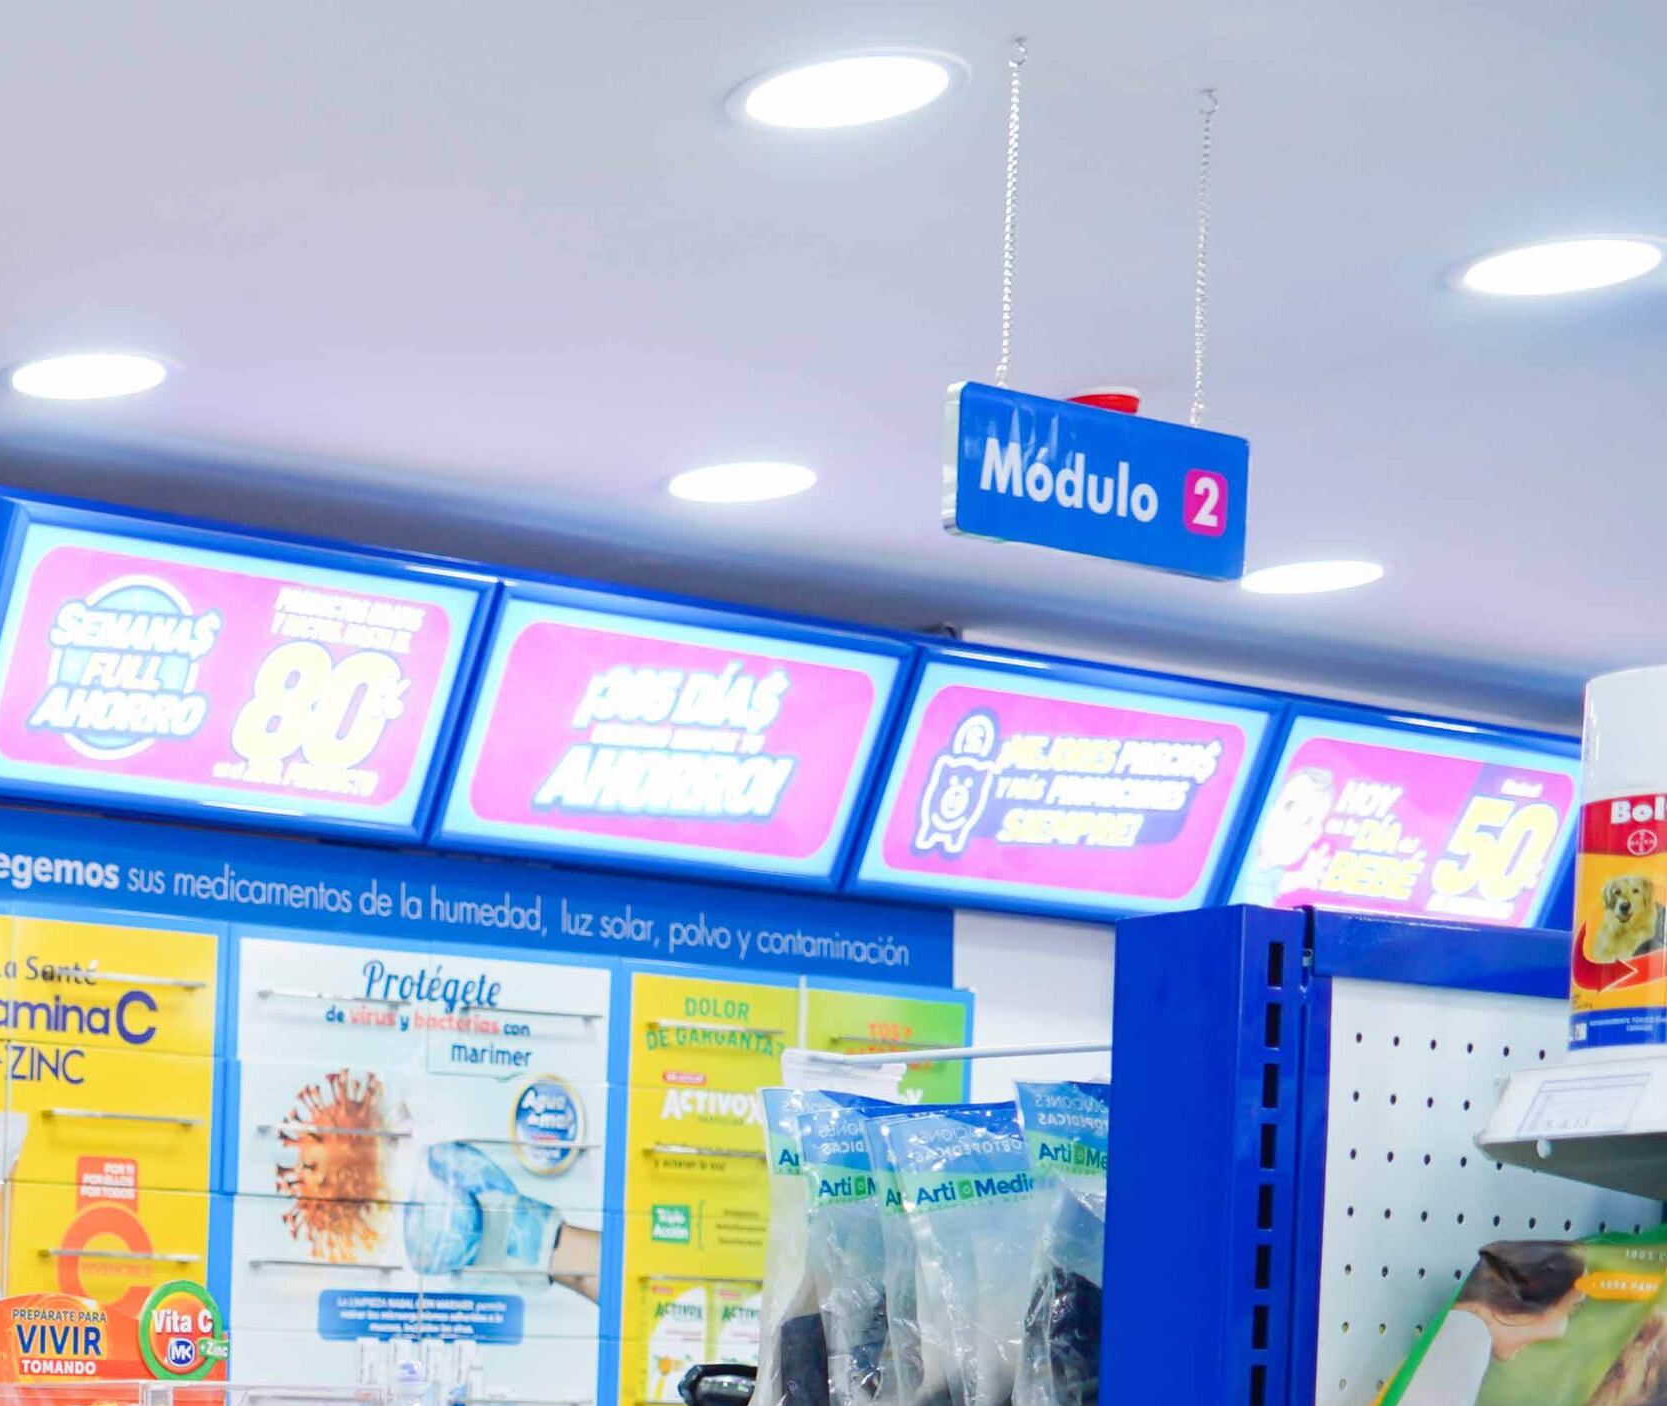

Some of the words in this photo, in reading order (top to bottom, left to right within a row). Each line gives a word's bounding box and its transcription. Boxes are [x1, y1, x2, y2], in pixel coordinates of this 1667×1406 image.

[980, 438, 1159, 524] Módulo
[1192, 476, 1219, 528] 2
[81, 652, 162, 690] FULL
[28, 685, 208, 737] AHORRO
[1611, 797, 1667, 825] Bol
[127, 868, 166, 894] sus
[174, 864, 353, 915] medicamentos
[359, 882, 392, 919] de
[400, 882, 422, 921] la
[430, 884, 547, 937] humedad,
[561, 899, 594, 939] luz
[600, 909, 660, 948] solar,
[669, 922, 732, 954] polvo
[736, 932, 751, 958] y
[757, 932, 910, 967] contaminación
[363, 960, 501, 1014] Protégete
[116, 990, 158, 1045] C
[326, 1006, 344, 1023] de
[349, 1007, 396, 1026] virus
[400, 1015, 409, 1031] y
[414, 1012, 499, 1034] bacterias
[503, 1022, 529, 1036] con
[685, 997, 750, 1020] DOLOR
[647, 1029, 668, 1050] DE
[451, 1042, 533, 1066] marimer
[661, 1089, 763, 1126] ACTIVOX
[1039, 1142, 1070, 1163] Arti
[818, 1176, 852, 1197] Arti
[916, 1177, 956, 1204] Arti
[12, 1308, 75, 1322] PREPÁRATE
[78, 1310, 106, 1322] PARA
[152, 1309, 192, 1334] Vita
[197, 1309, 213, 1333] C
[16, 1324, 102, 1356] VIVIR
[170, 1341, 193, 1361] MK
[22, 1359, 96, 1375] TOMANDO
